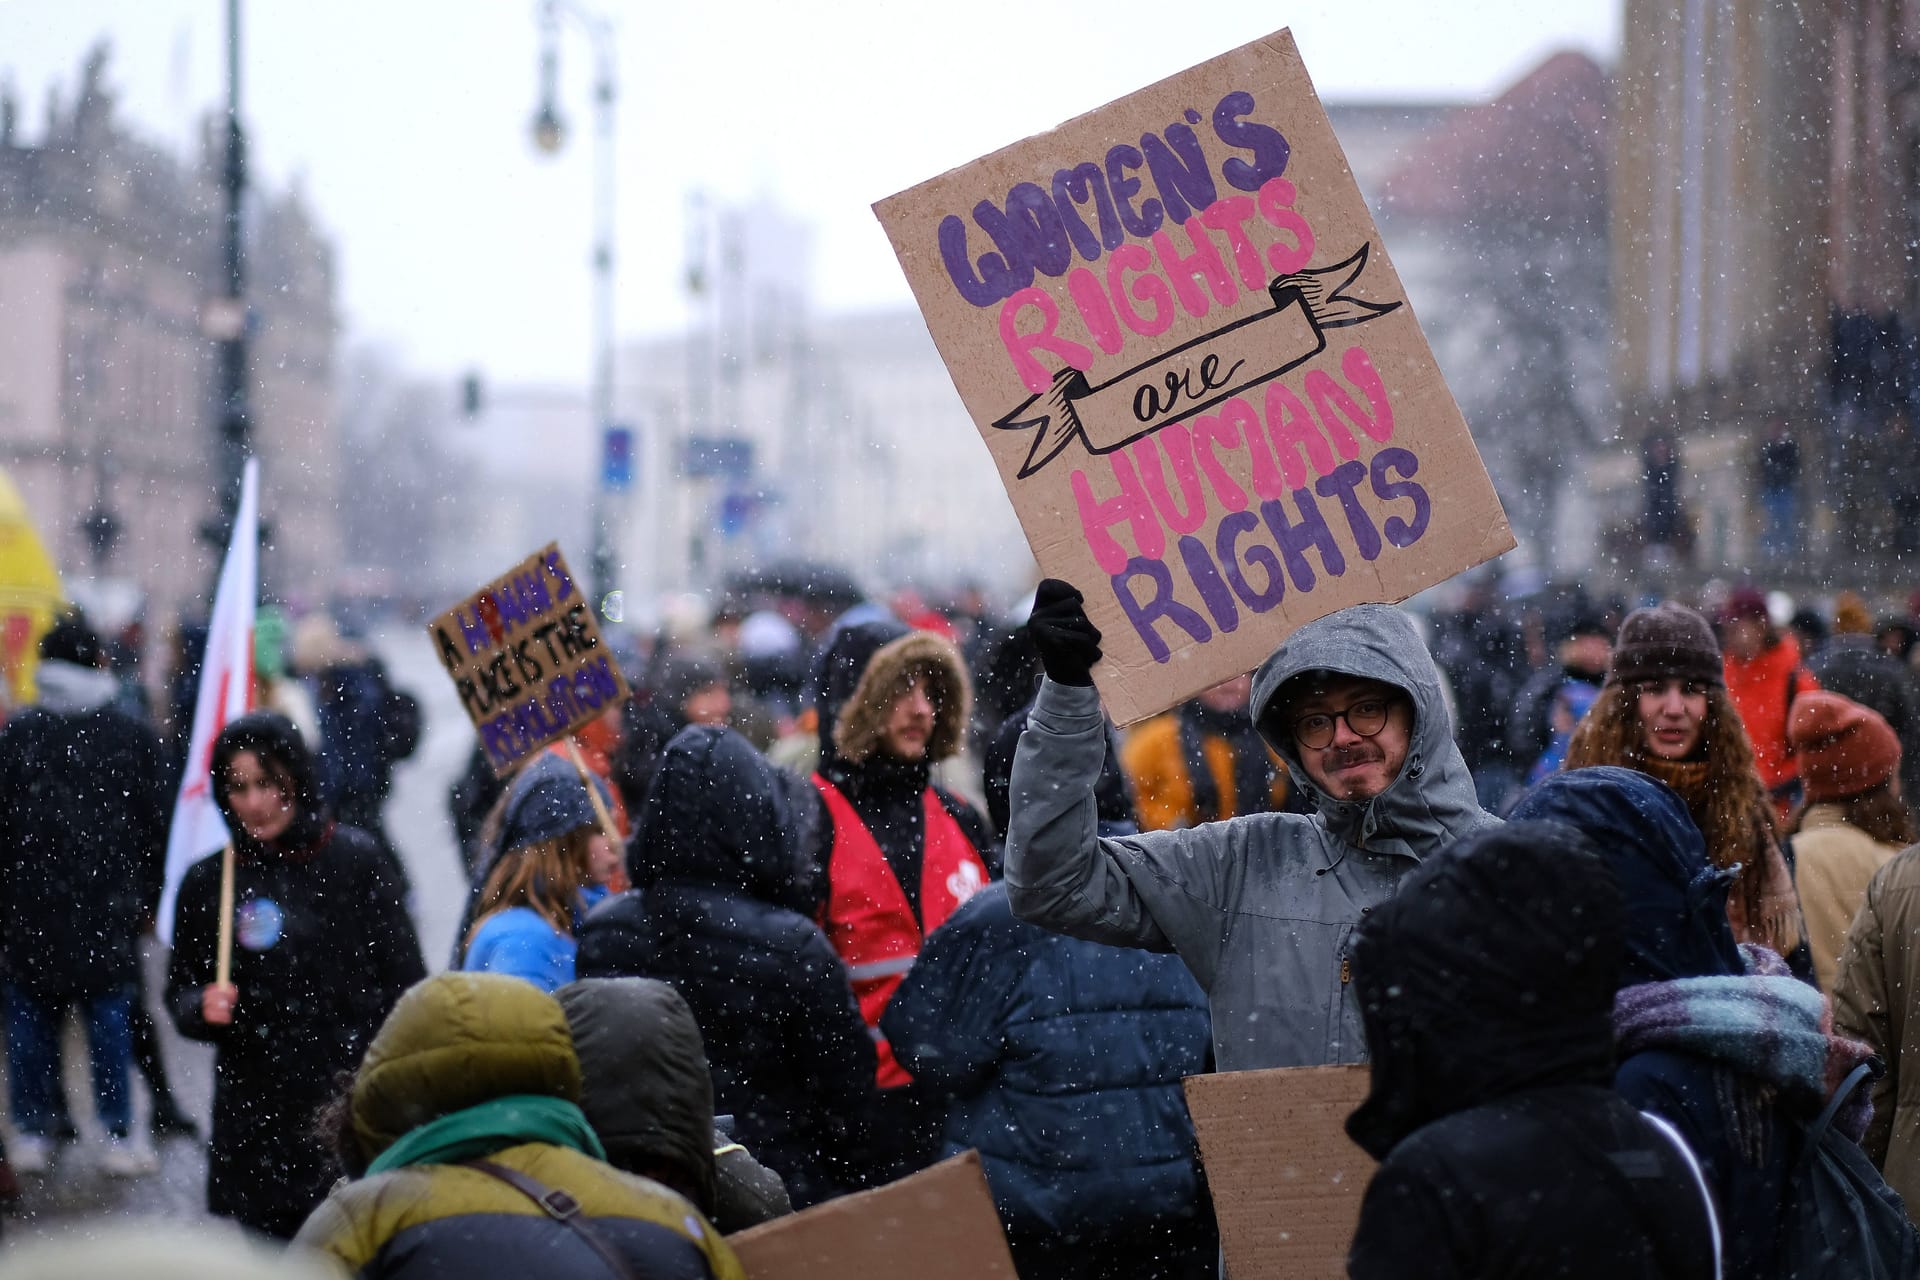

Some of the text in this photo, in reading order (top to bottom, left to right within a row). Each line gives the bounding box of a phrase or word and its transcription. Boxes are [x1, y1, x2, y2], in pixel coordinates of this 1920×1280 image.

[938, 91, 1290, 307] WOMEN'S
[999, 177, 1315, 394] RIGHTS
[1071, 347, 1393, 575] HUMAN
[1133, 354, 1245, 422] are
[1111, 447, 1430, 663] RIGHTS
[436, 628, 464, 665] A
[457, 603, 597, 715] PLACE IS THE
[479, 656, 619, 764] REVOLUTION
